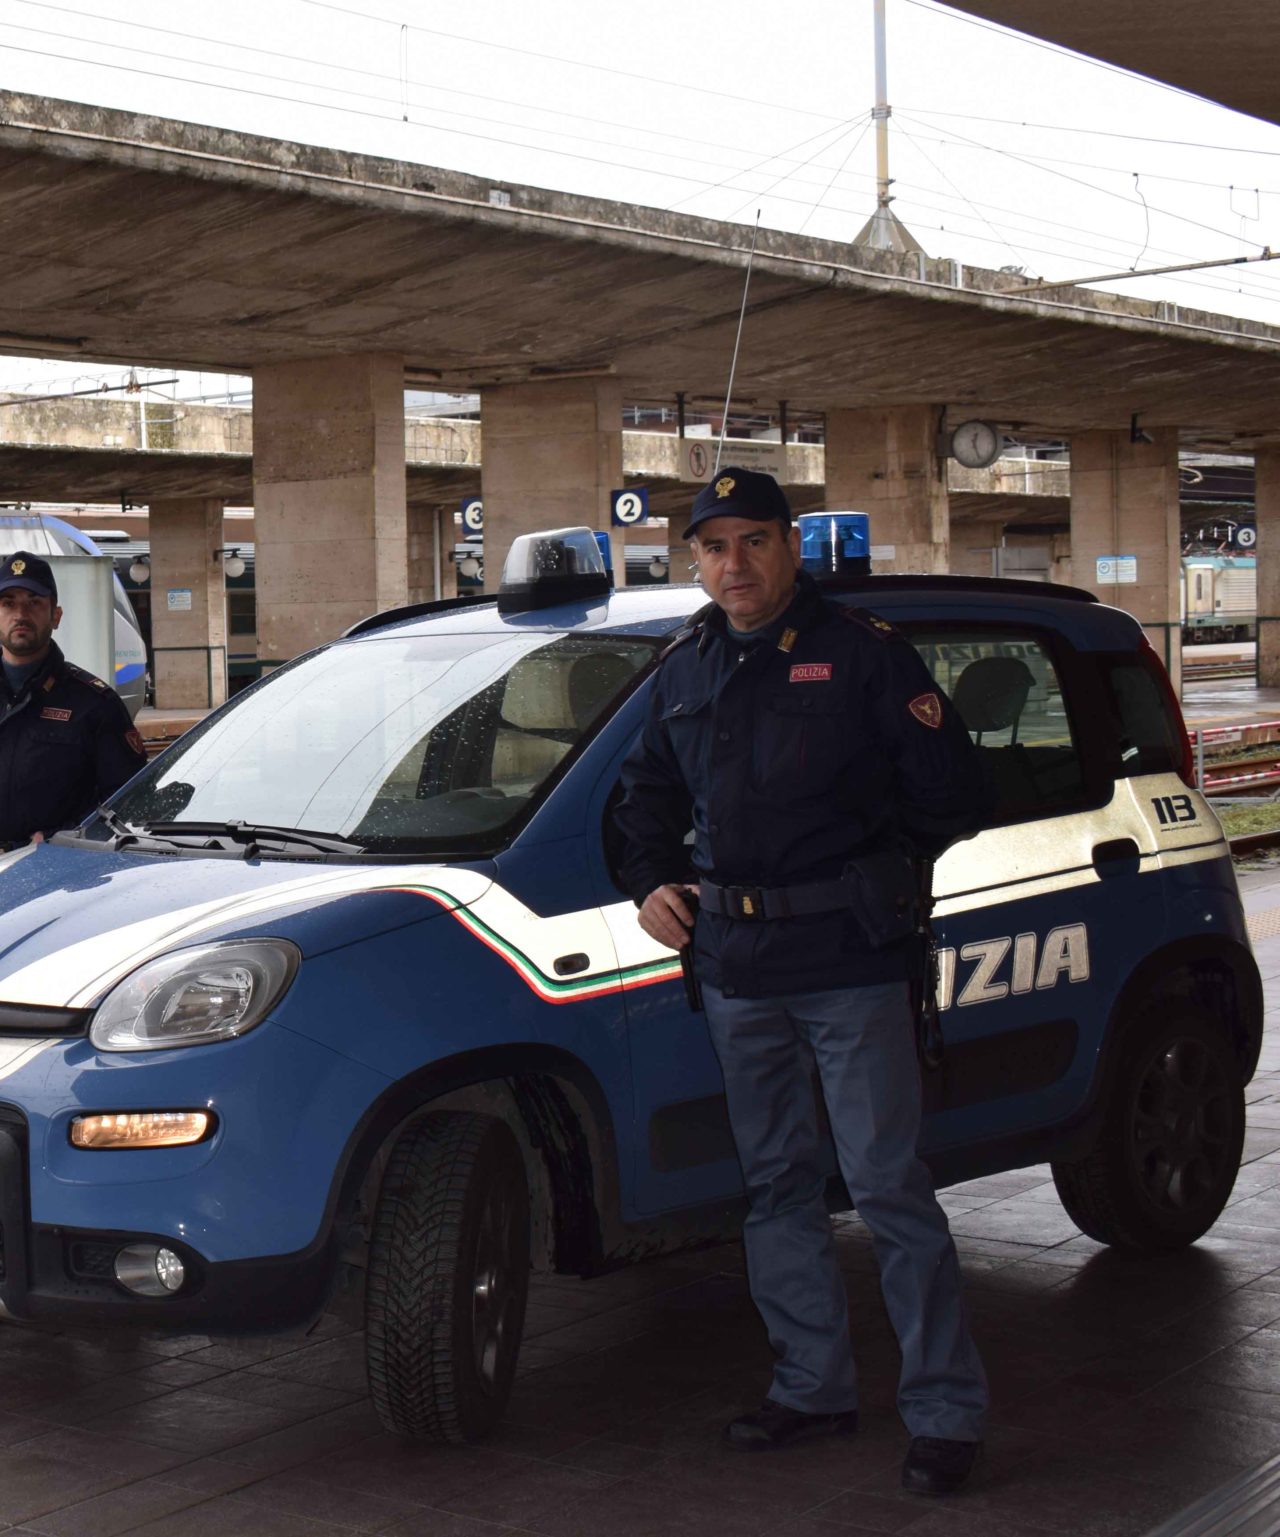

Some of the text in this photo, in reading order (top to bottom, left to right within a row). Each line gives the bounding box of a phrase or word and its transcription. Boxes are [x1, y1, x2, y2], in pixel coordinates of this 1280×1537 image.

[471, 506, 484, 525] 3
[623, 498, 635, 517] 2
[1242, 531, 1251, 543] 3
[791, 666, 829, 678] POLIZIA
[1151, 794, 1197, 825] 113
[936, 922, 1090, 1012] IZIA
